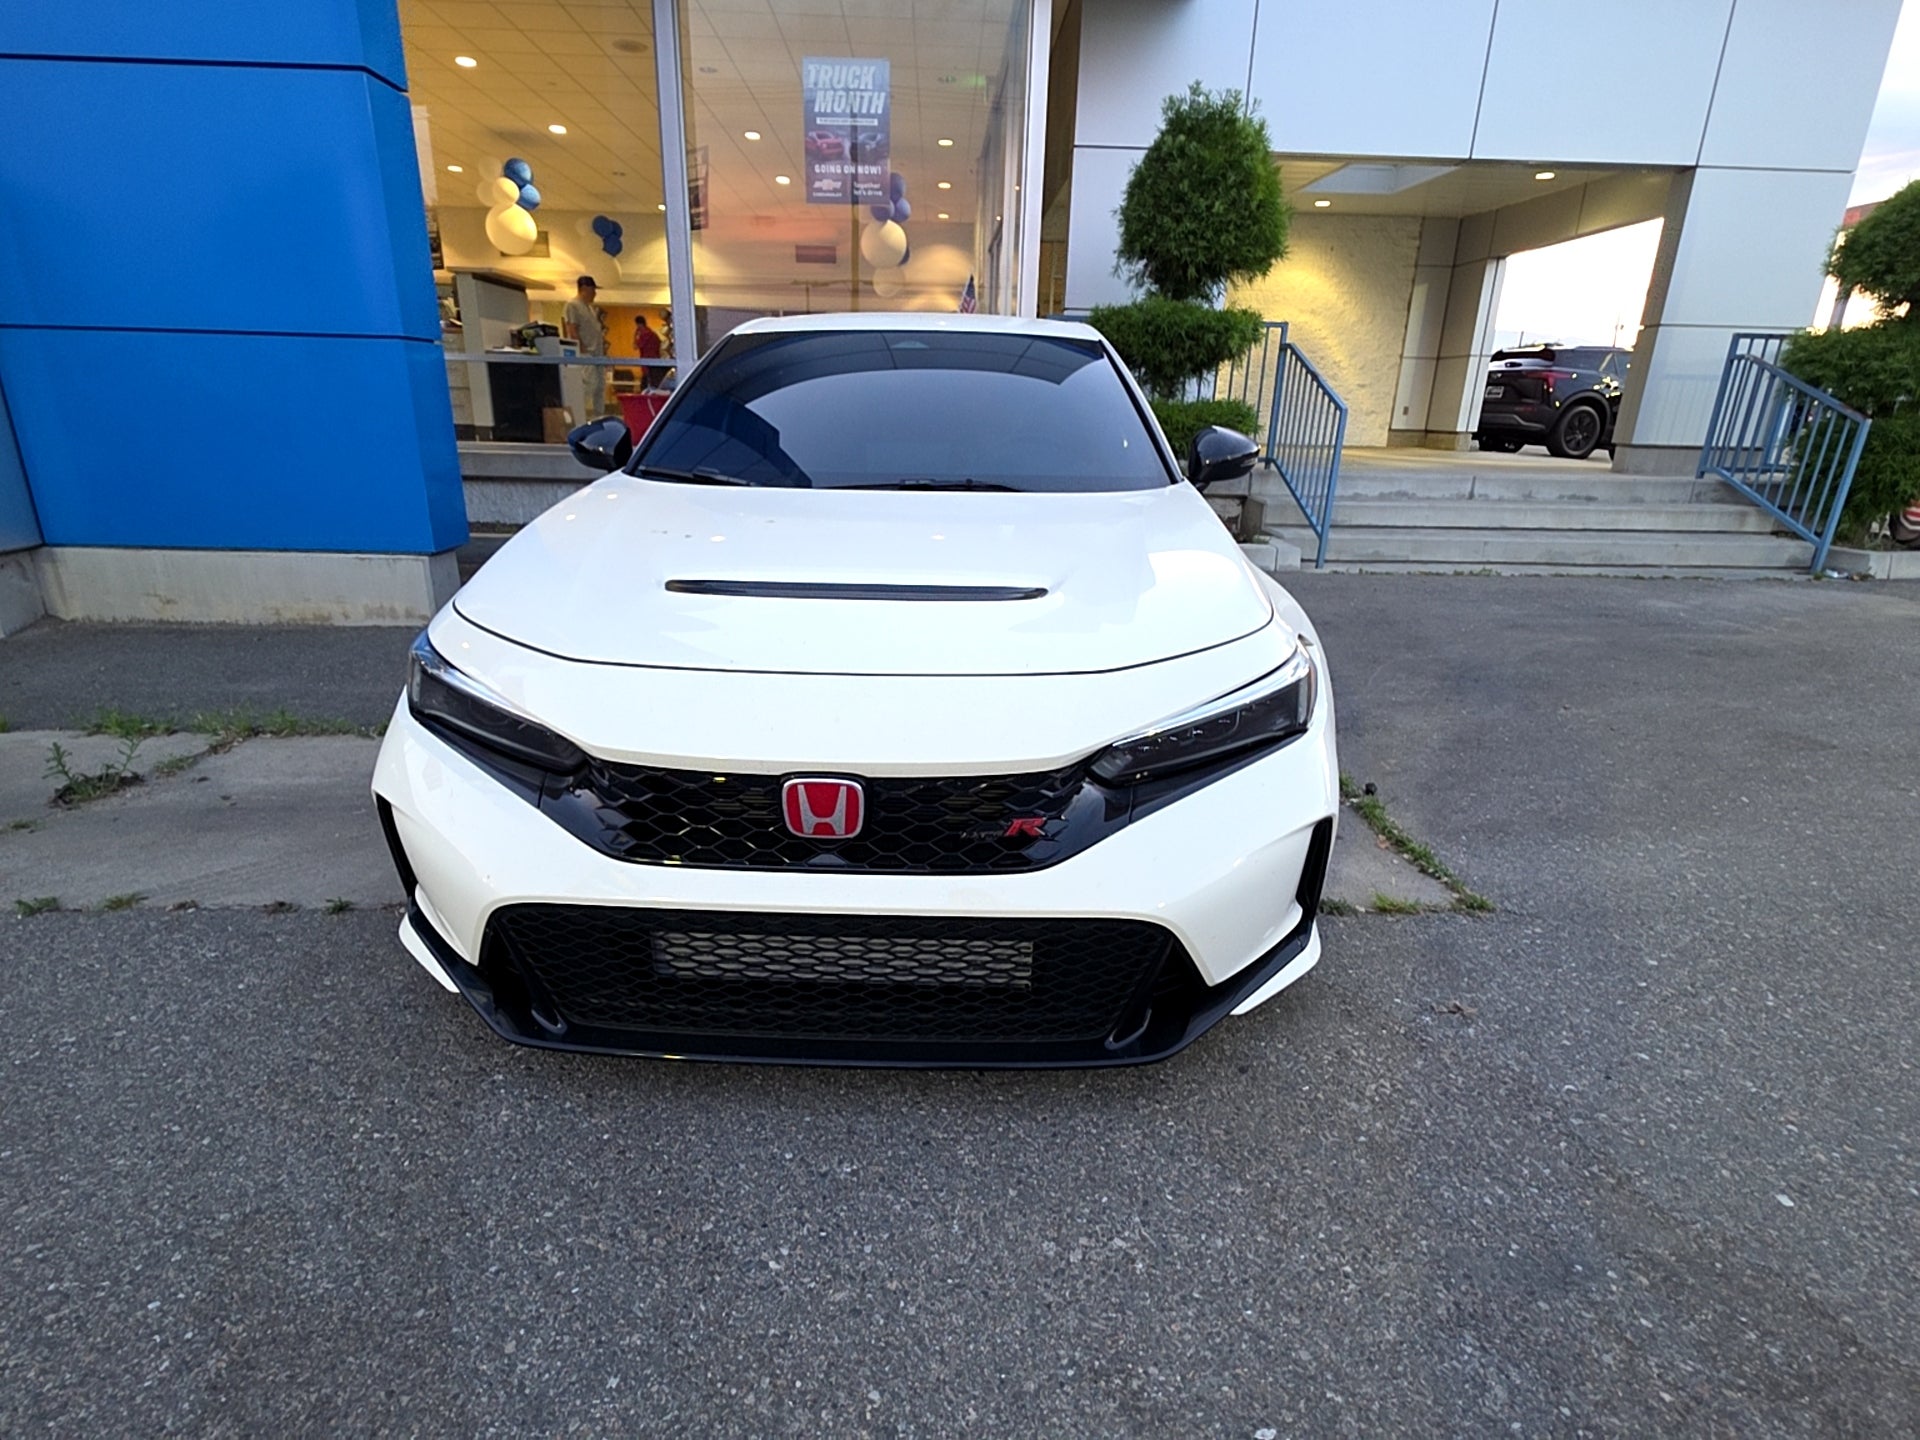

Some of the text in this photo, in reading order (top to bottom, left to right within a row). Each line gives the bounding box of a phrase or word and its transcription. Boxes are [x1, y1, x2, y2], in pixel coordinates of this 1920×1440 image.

[807, 64, 876, 90] TRUCK
[814, 90, 886, 114] MONTH
[814, 164, 882, 175] GOING ON NOW!
[1003, 817, 1047, 837] R
